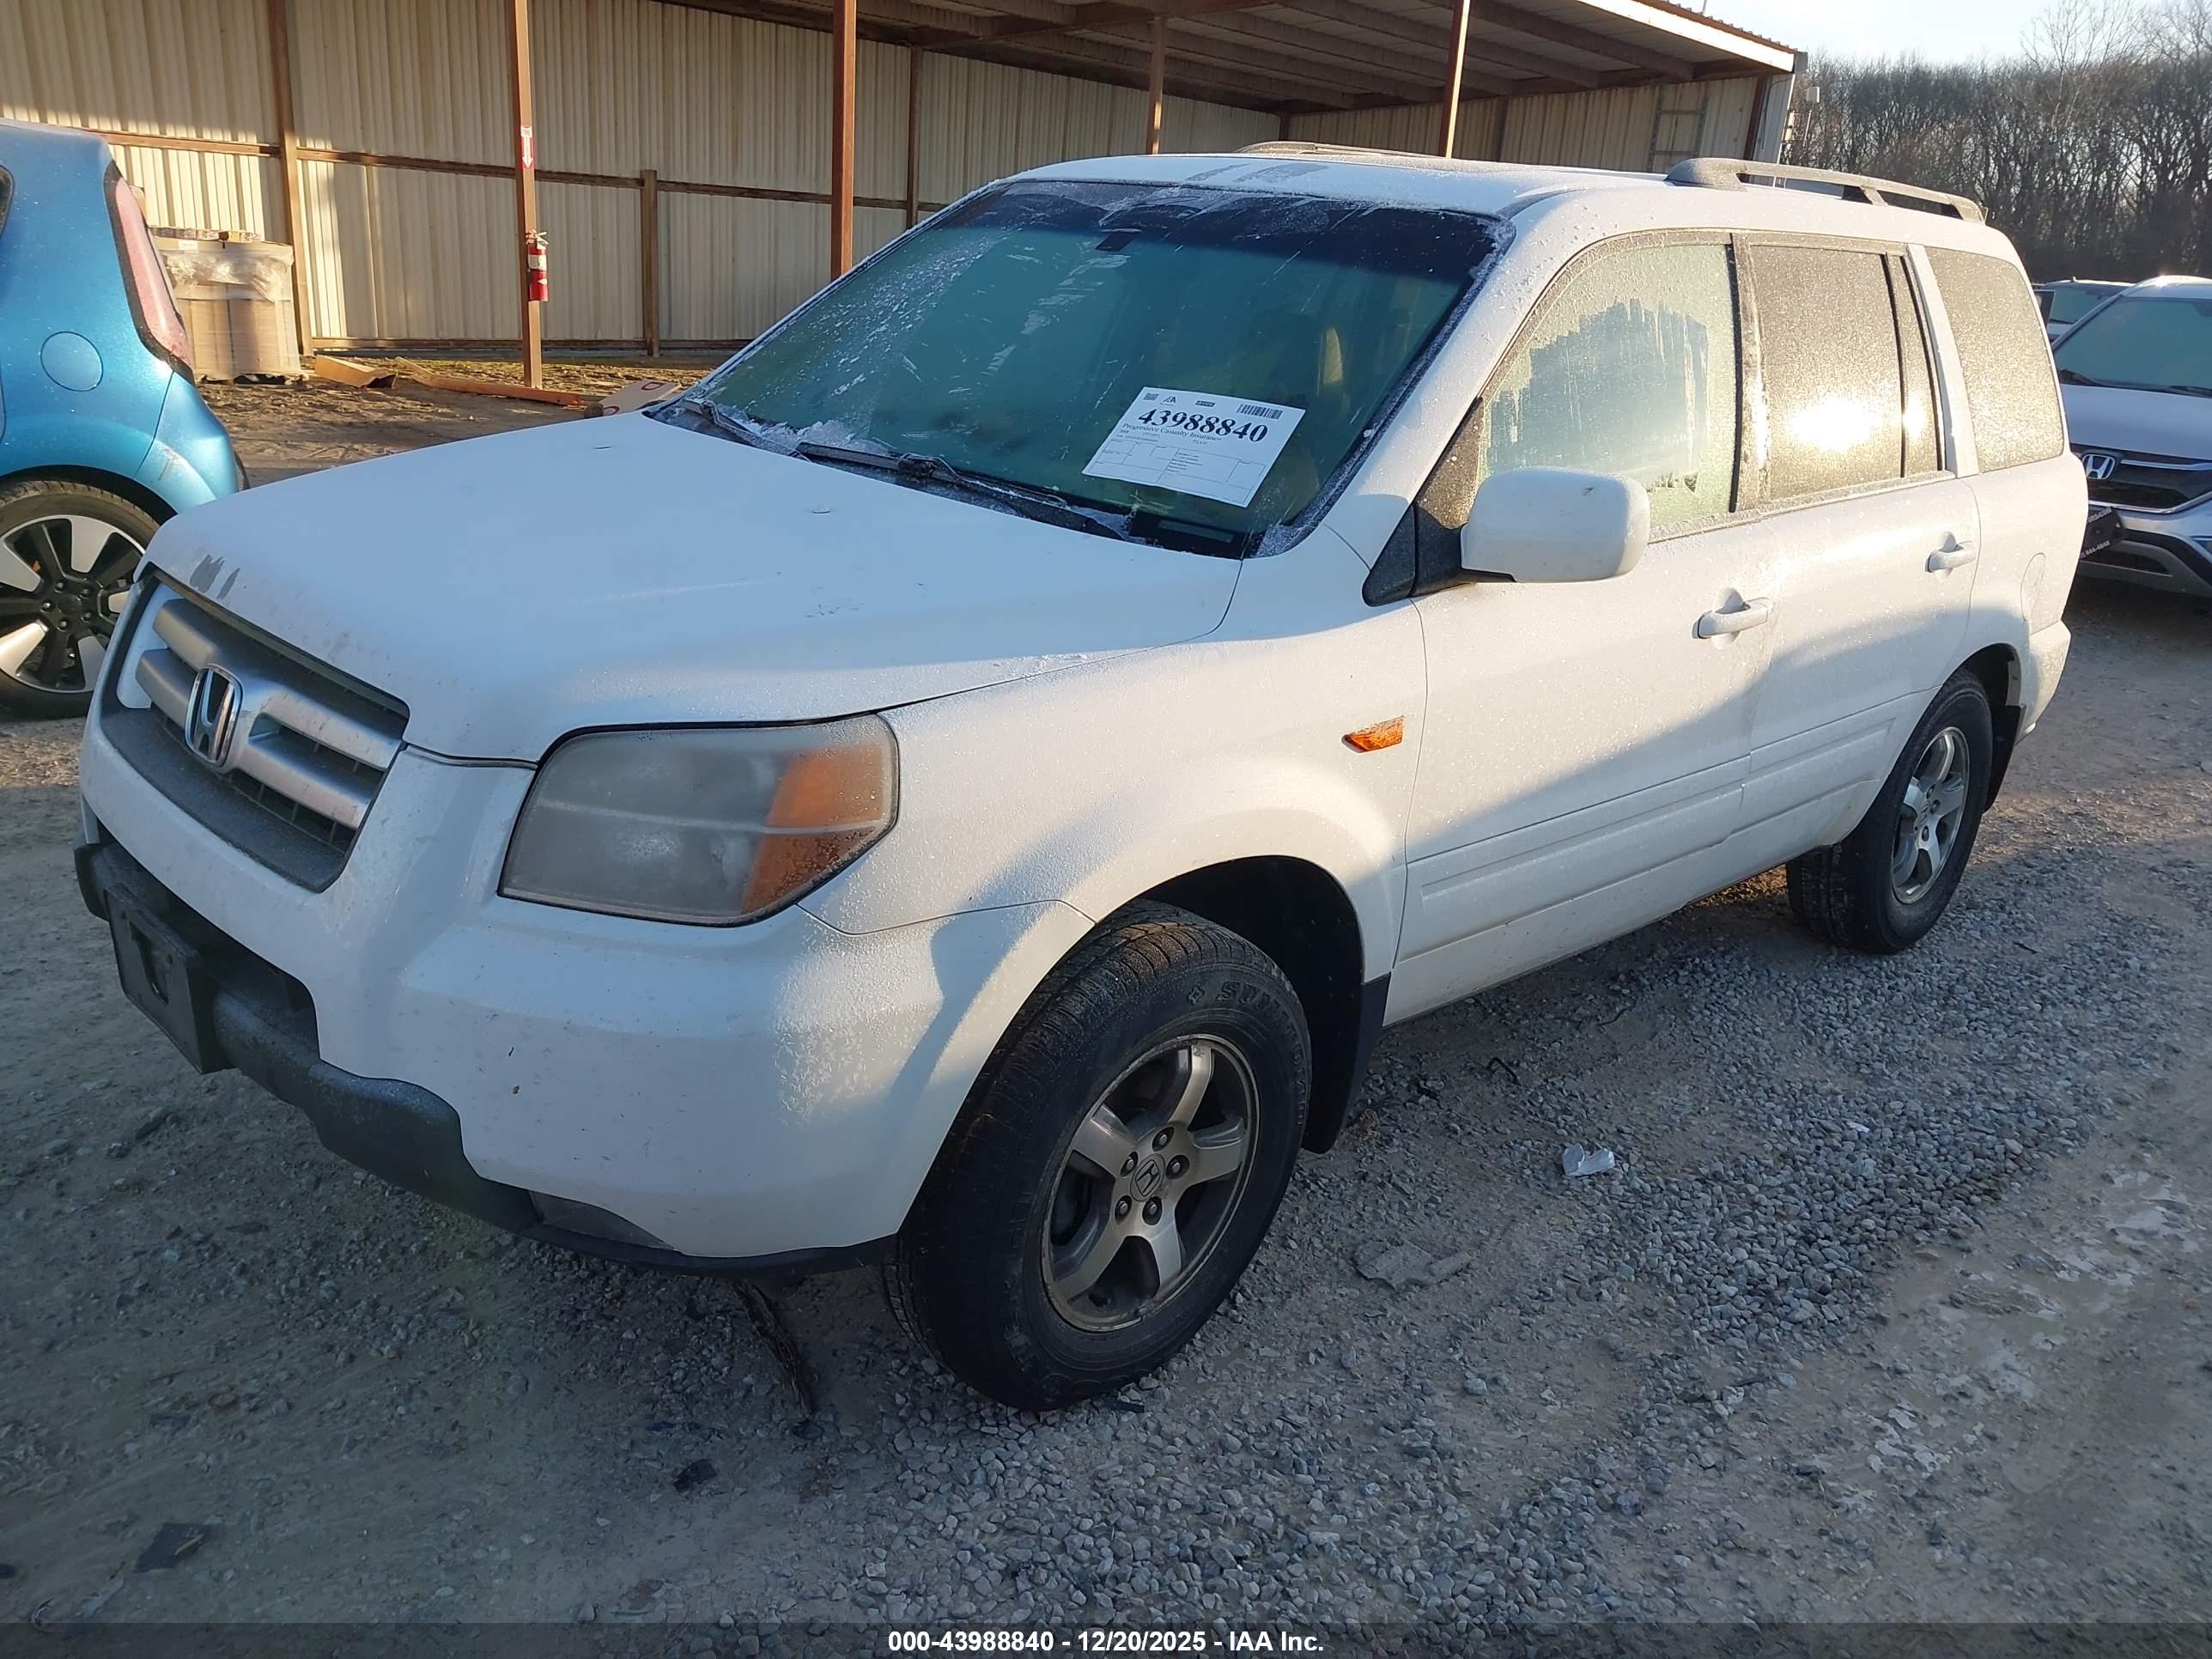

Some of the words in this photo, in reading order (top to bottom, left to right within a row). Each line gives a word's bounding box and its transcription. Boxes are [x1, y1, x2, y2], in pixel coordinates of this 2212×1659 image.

[1122, 423, 1159, 436] Progressive
[1160, 428, 1189, 438] Casualty
[1190, 432, 1222, 441] Insurance
[1138, 408, 1268, 442] 43988840
